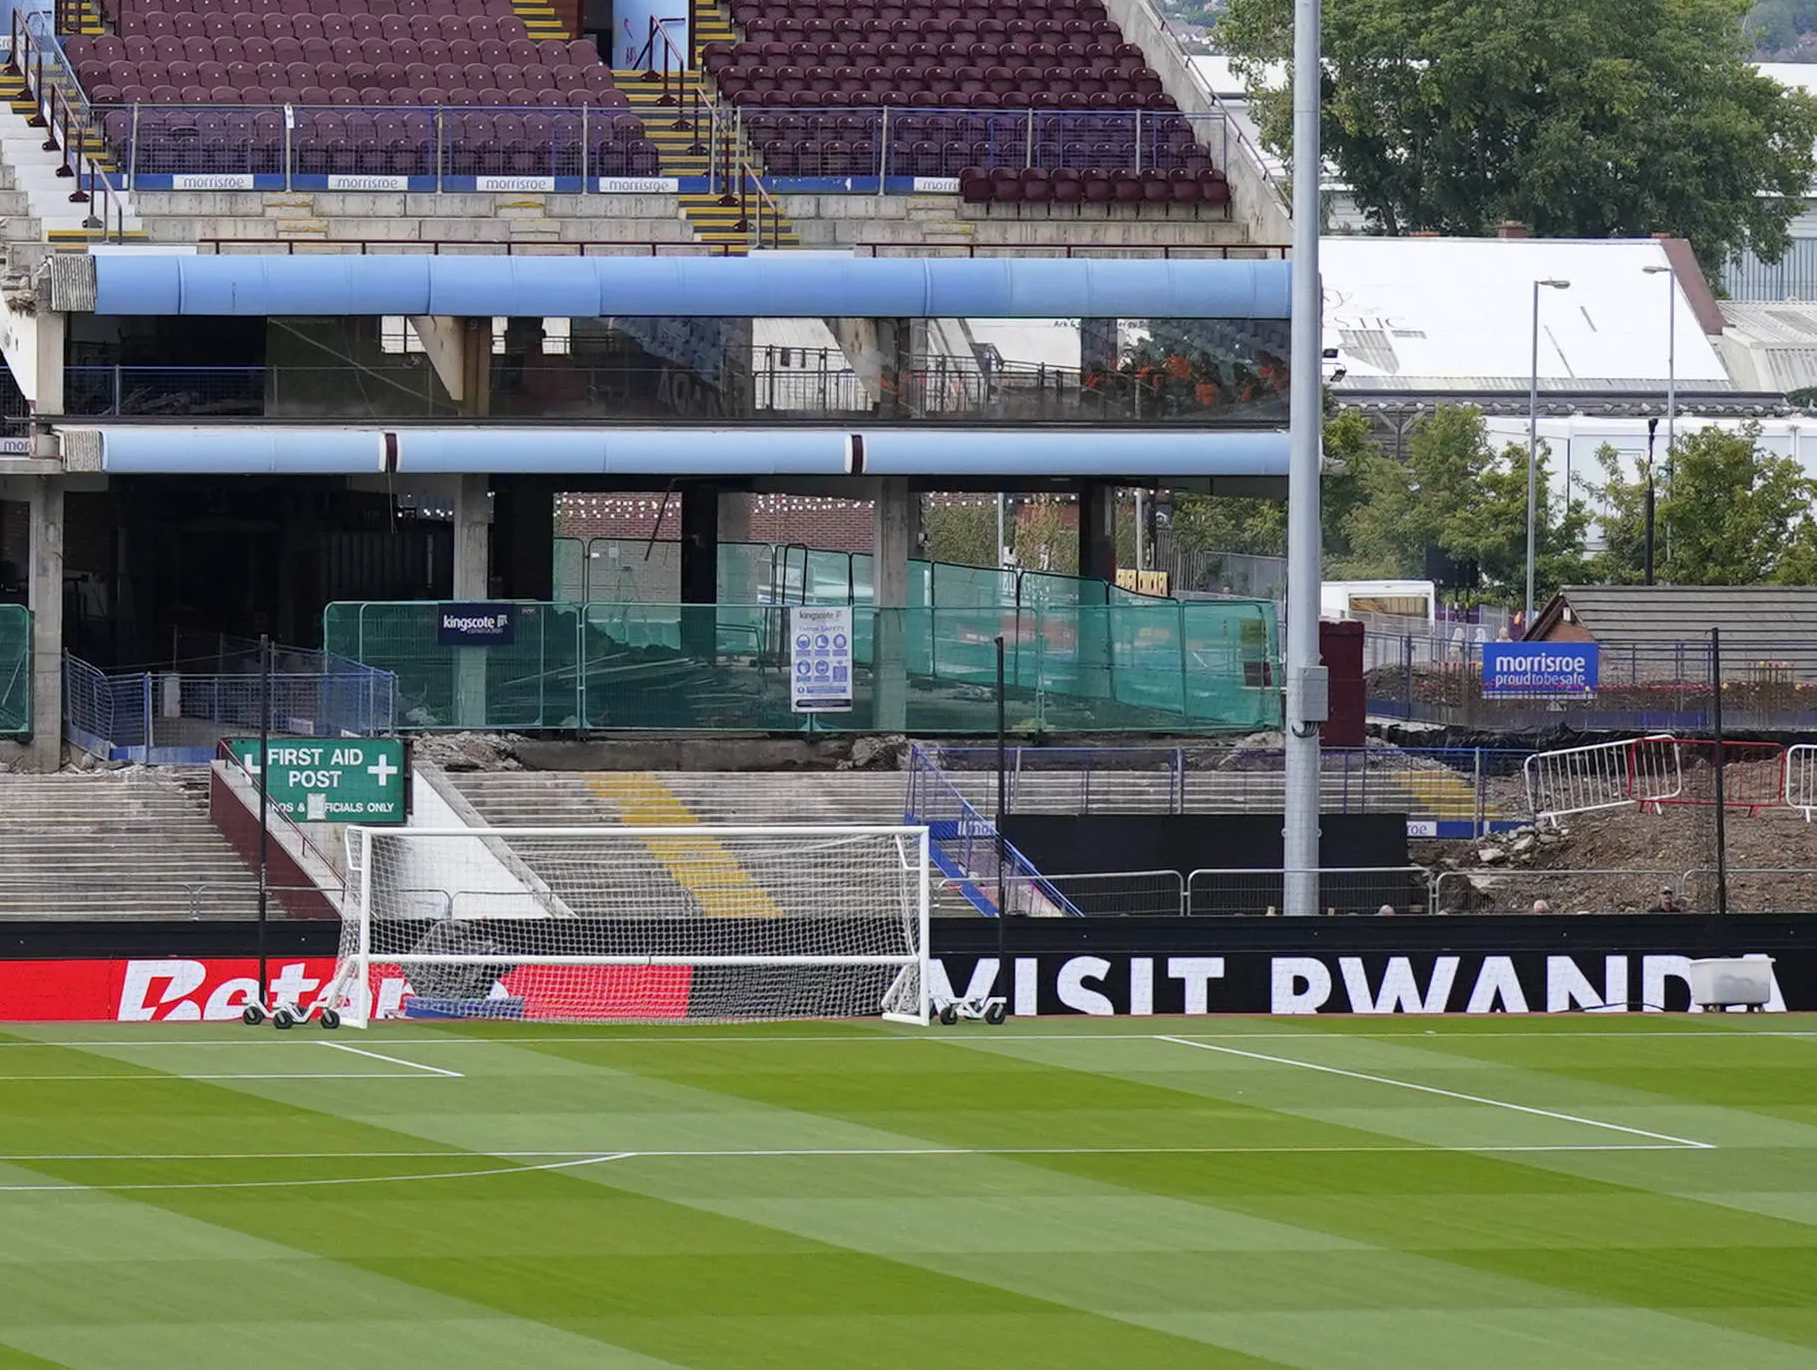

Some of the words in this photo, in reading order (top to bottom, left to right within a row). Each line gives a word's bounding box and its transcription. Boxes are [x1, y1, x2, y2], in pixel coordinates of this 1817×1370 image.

[183, 176, 244, 189] morrisroe
[337, 176, 398, 189] morrisroe
[486, 178, 546, 191] morrisroe
[609, 179, 669, 192] morrisroe
[443, 614, 495, 632] kingscote
[1495, 652, 1586, 672] morrisroe
[267, 748, 324, 766] FIRST
[330, 748, 363, 766] AID
[288, 770, 342, 788] POST
[297, 802, 305, 812] &
[324, 802, 364, 812] FICIALS
[367, 802, 394, 812] ONLY
[927, 954, 1226, 1016] VISIT
[1270, 954, 1789, 1014] RWAND
